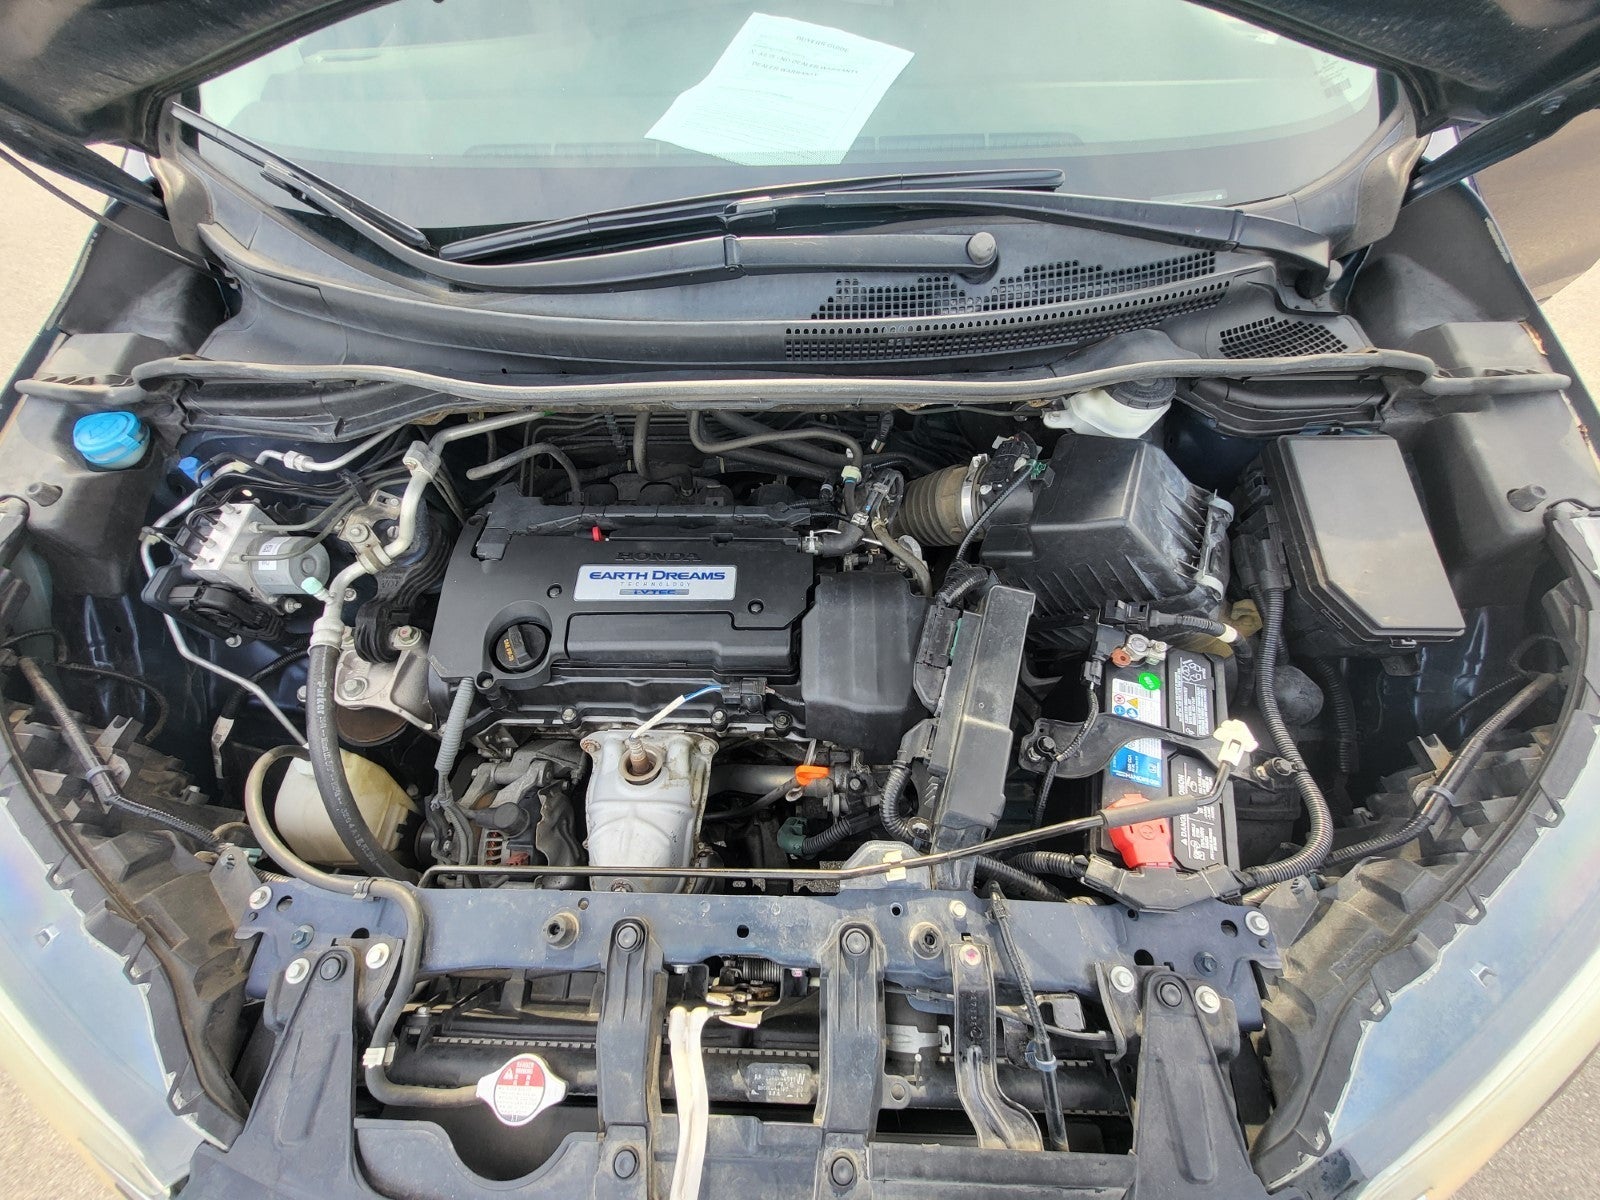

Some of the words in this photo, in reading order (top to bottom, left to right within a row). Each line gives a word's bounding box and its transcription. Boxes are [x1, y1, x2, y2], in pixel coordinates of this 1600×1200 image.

[752, 60, 780, 71] DEALER
[615, 552, 702, 562] HONDA
[589, 571, 649, 580] EARTH
[652, 570, 726, 580] DREAMS
[316, 680, 327, 715] Parker
